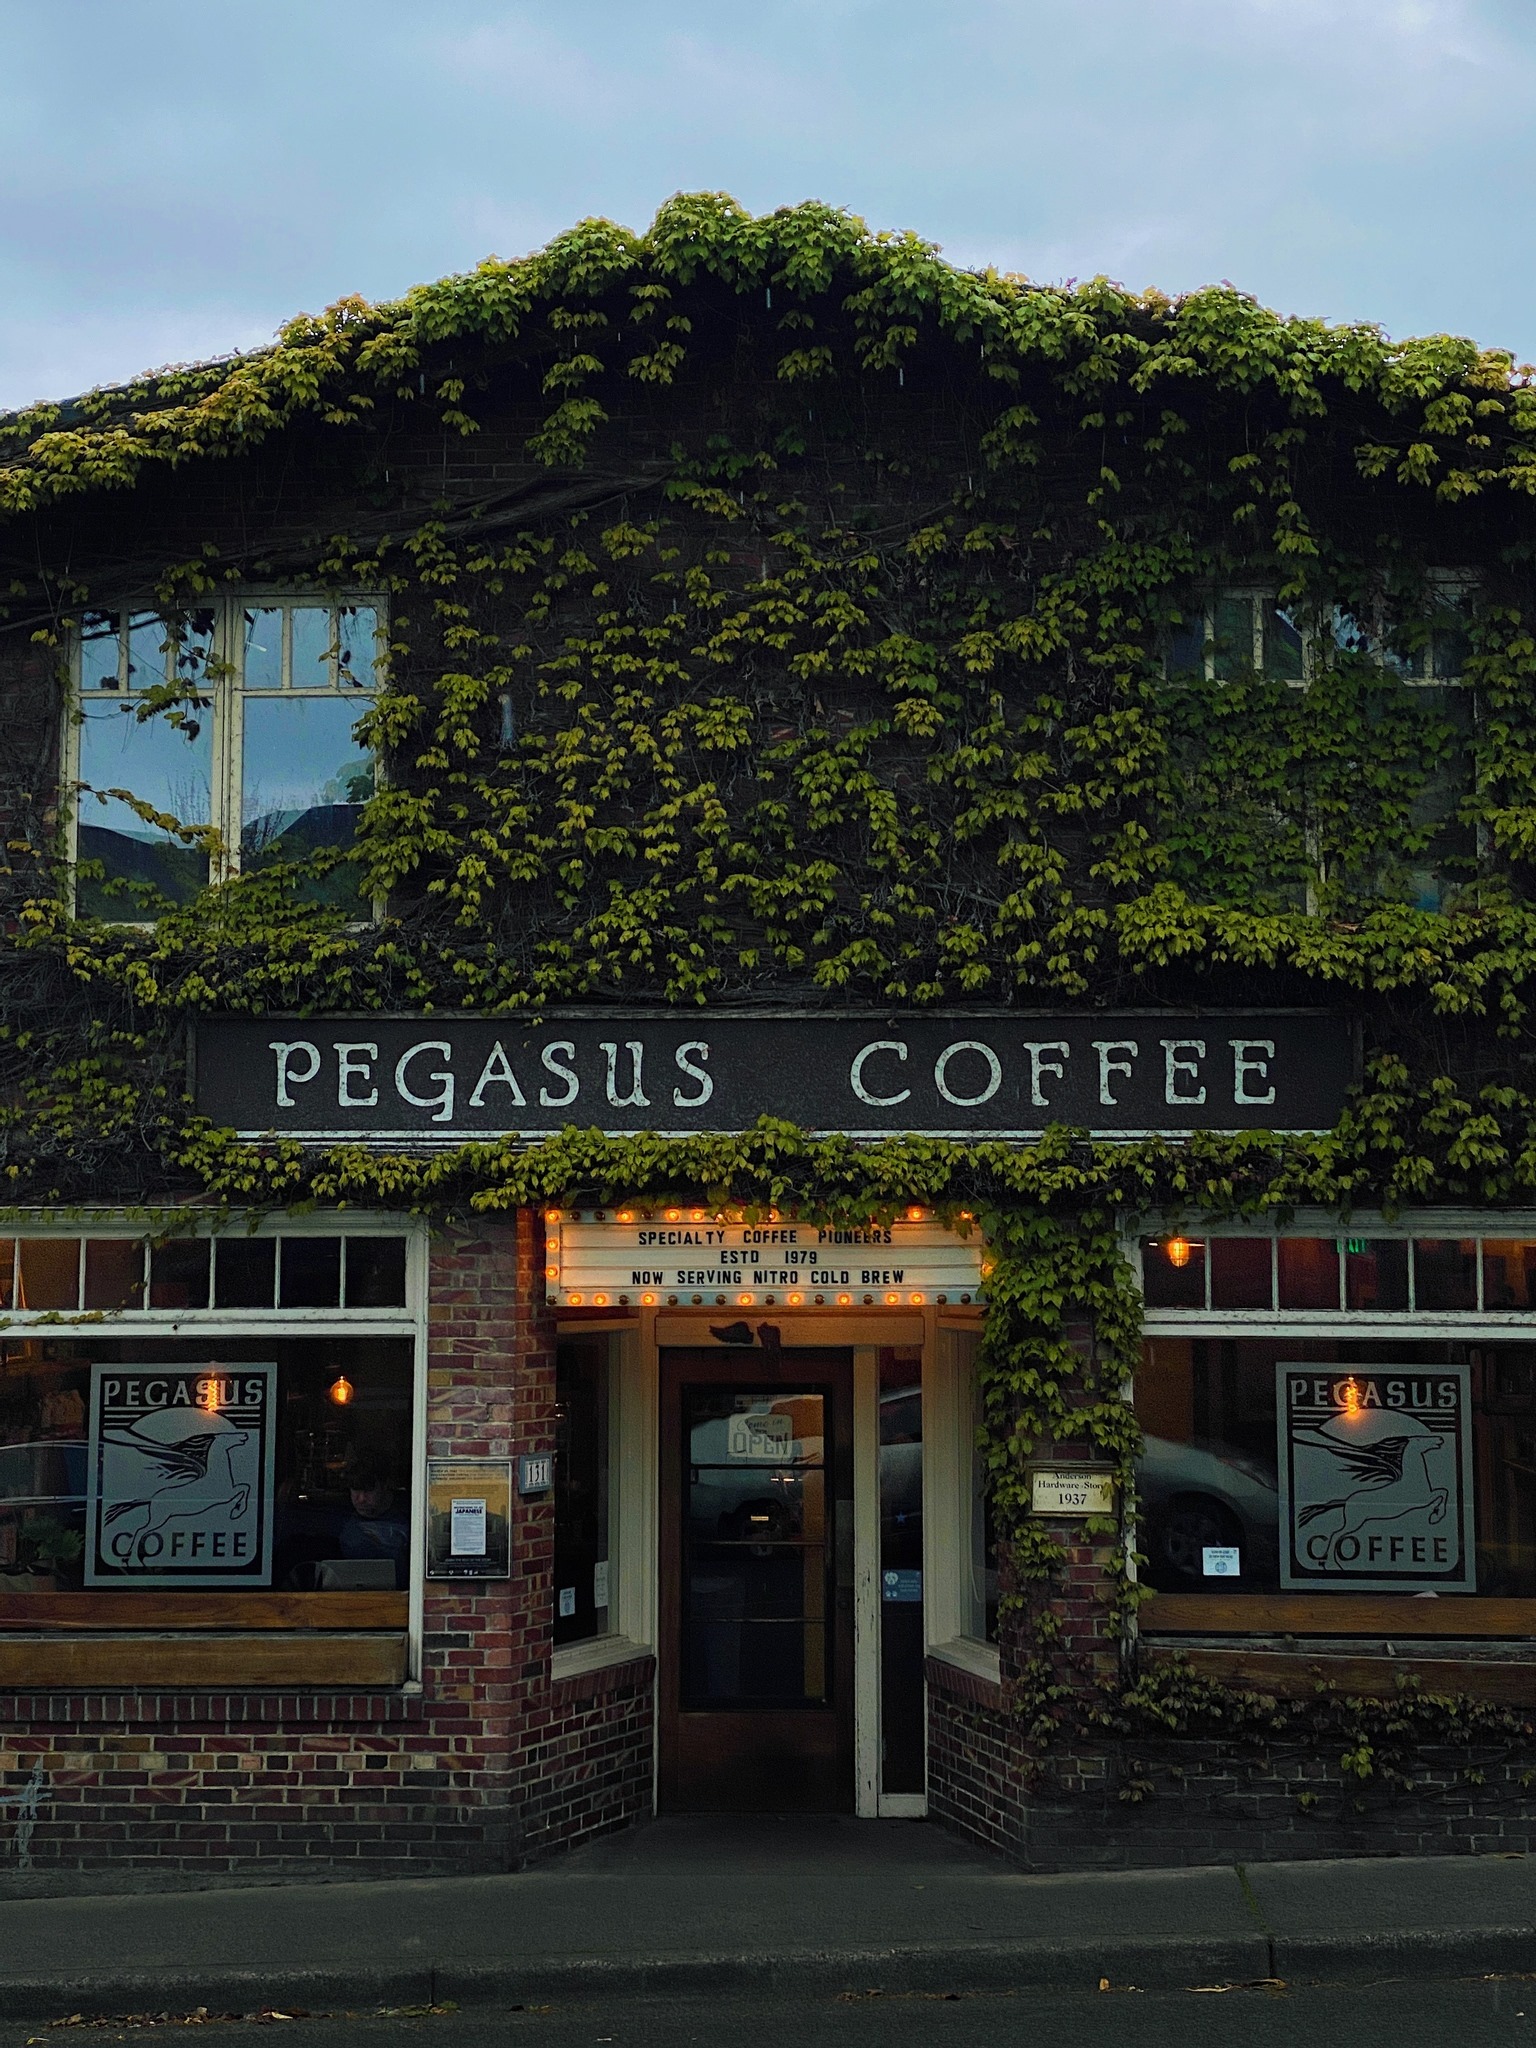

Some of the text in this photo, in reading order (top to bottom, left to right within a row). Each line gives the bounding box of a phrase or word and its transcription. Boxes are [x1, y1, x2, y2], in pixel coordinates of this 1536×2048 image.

[269, 1040, 1276, 1121] PEGASUS COFFEE
[638, 1230, 892, 1246] SPECIALTY COFFEE PIONEERS
[720, 1250, 818, 1264] ESTD 1979
[632, 1269, 904, 1285] NOW SERVING NITRO COLD BREW
[103, 1379, 263, 1406] PEGASUS
[1290, 1379, 1457, 1408] PEGASUS
[733, 1432, 789, 1455] OPEN
[1038, 1480, 1105, 1490] Hardware Stor
[1058, 1493, 1088, 1506] 1937
[111, 1531, 248, 1558] COFFEE
[1306, 1534, 1448, 1563] COFFEE
